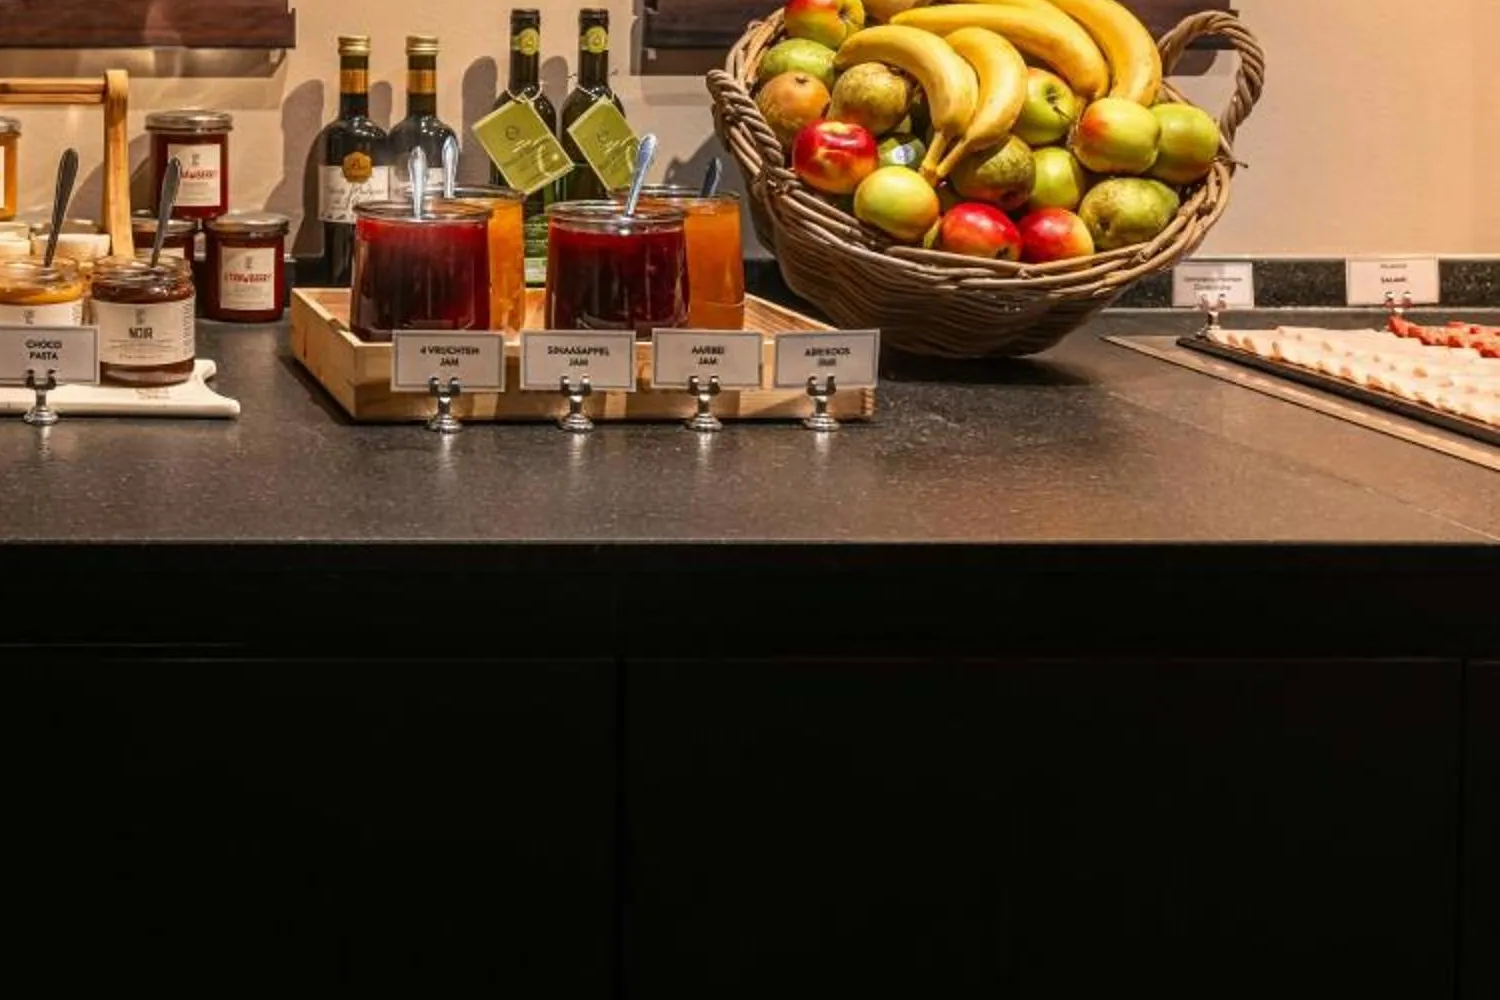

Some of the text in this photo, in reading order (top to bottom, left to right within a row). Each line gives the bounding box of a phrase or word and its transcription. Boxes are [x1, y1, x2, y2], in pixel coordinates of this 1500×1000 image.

[128, 327, 153, 339] NOIR
[24, 339, 62, 349] CHOCO
[29, 351, 59, 361] PASTA
[439, 357, 459, 367] JAM
